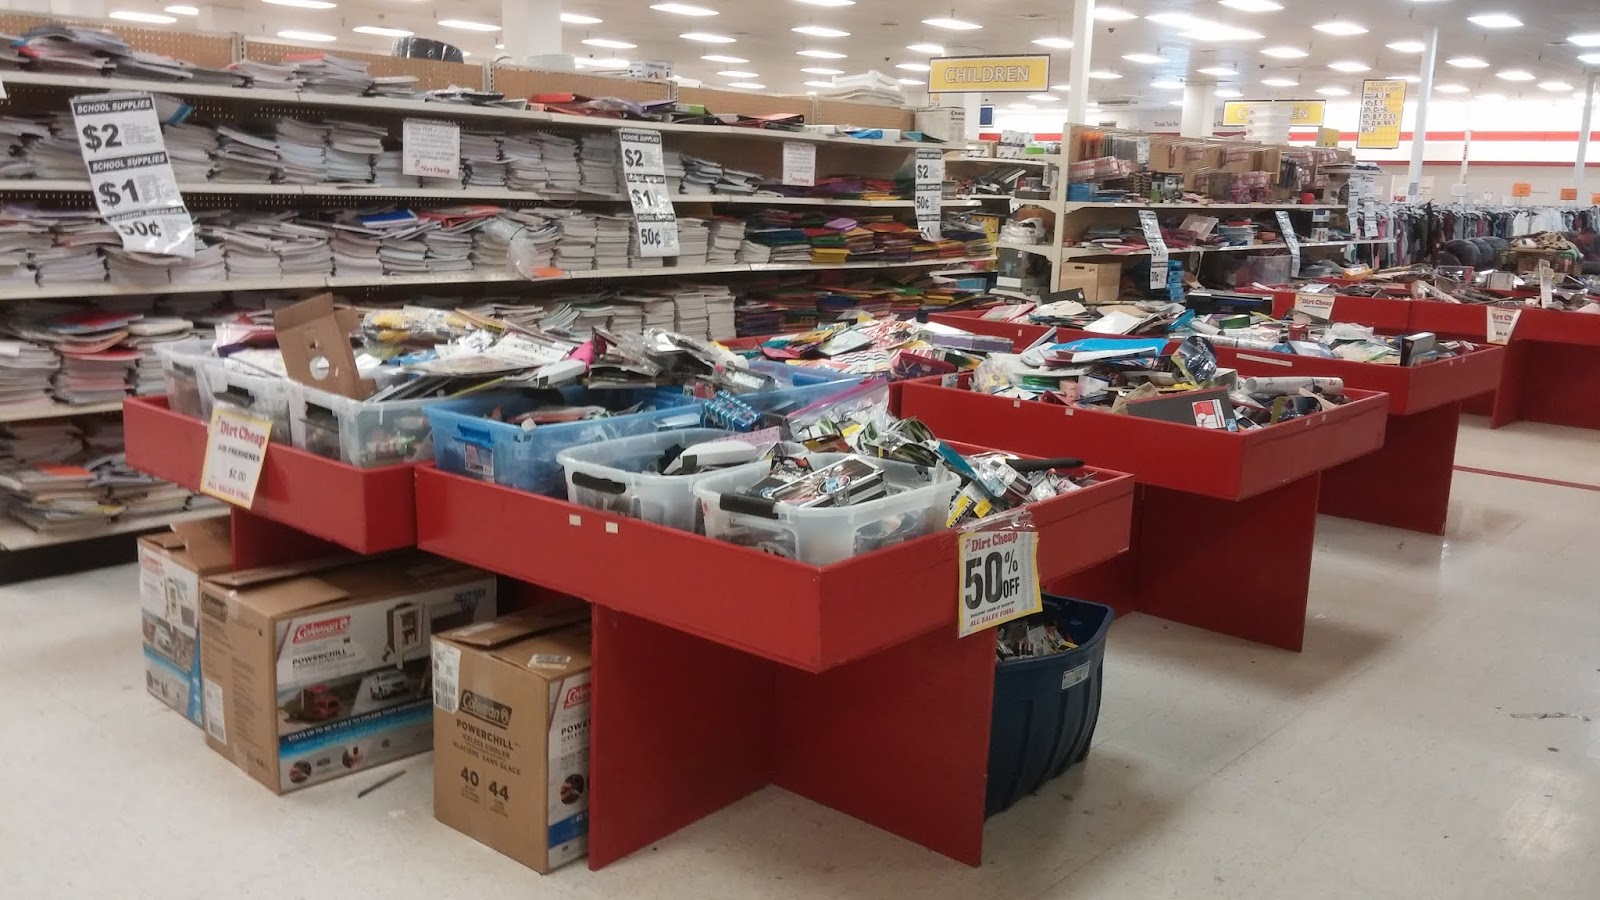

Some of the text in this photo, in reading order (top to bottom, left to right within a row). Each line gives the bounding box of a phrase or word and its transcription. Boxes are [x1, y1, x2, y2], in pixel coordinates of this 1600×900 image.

[944, 65, 1030, 84] CHILDREN
[77, 99, 150, 115] SCHOOL SUPPLIES
[82, 123, 122, 152] $2
[92, 154, 165, 172] SCHOOL SUPPLIES
[624, 148, 644, 168] $2
[917, 164, 929, 179] $2
[98, 178, 140, 209] $1
[631, 188, 652, 208] $1
[641, 228, 661, 248] 50¢
[220, 421, 266, 449] Dirt Cheap
[218, 444, 227, 453] AIR
[229, 468, 246, 481] $2.00
[971, 532, 1018, 552] Dirt Cheap
[1003, 576, 1020, 598] OFF
[970, 607, 1015, 627] ALL SALES FINAL
[297, 622, 339, 640] Coleman
[292, 649, 345, 665] POWERCHILL
[462, 692, 500, 721] Coleman
[456, 718, 514, 751] POWERCHILL
[485, 743, 510, 759] COOLER
[461, 767, 479, 787] 40
[489, 781, 509, 801] 44
